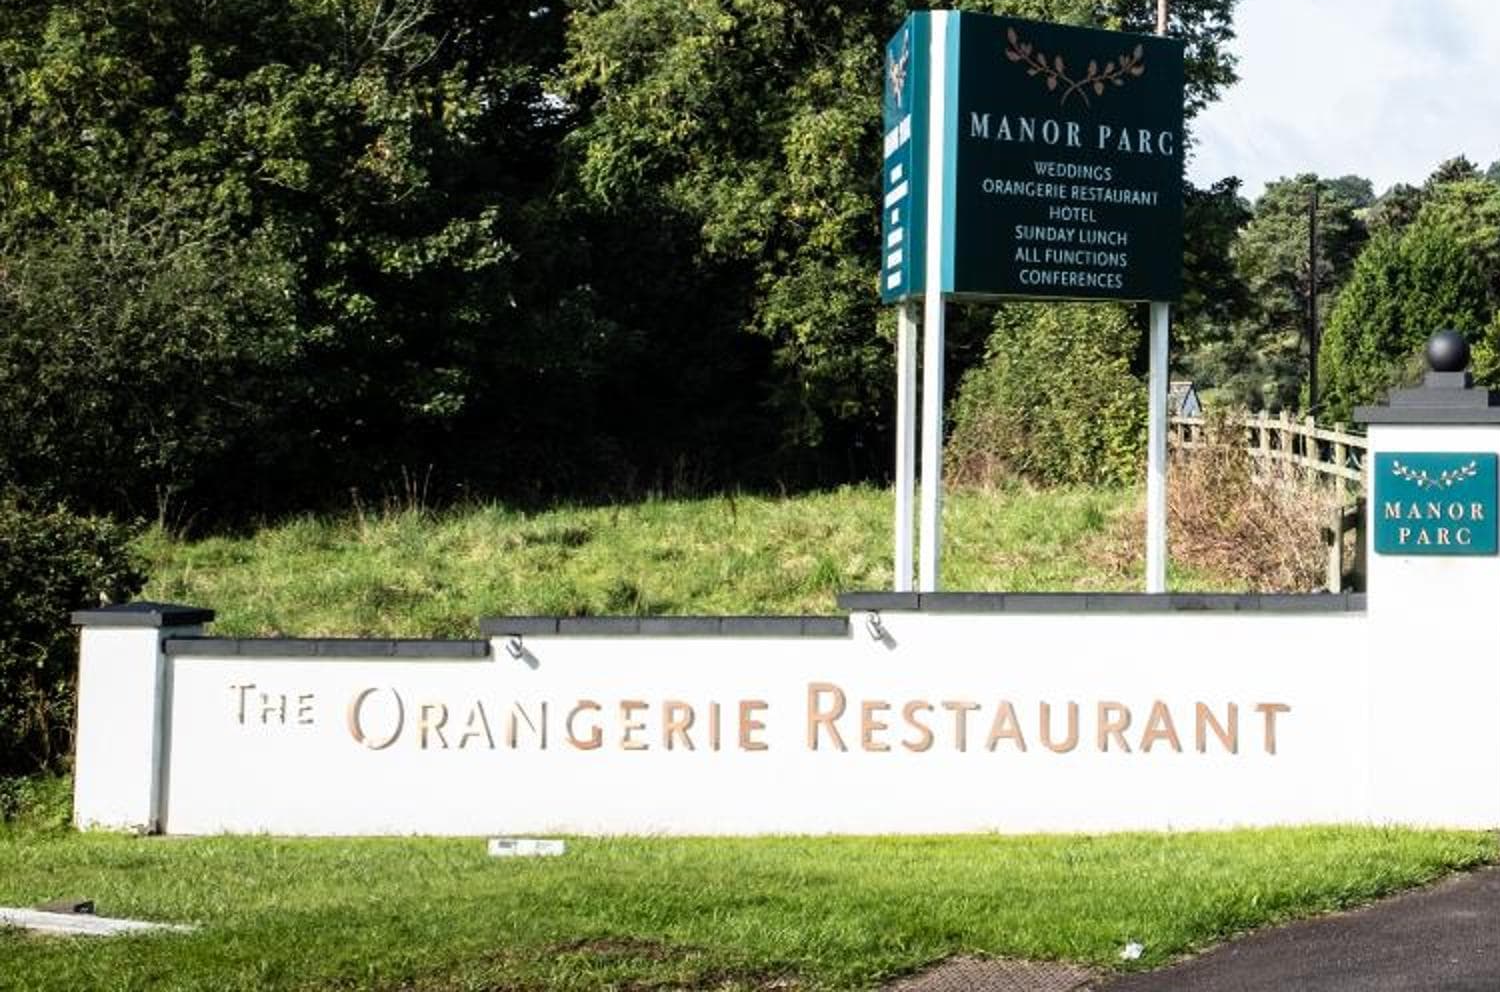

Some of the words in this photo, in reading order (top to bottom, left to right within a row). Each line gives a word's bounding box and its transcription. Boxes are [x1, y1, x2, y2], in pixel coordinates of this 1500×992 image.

[969, 111, 1081, 148] MANOR
[1098, 124, 1174, 156] PARC
[1033, 160, 1113, 181] WEDDINGS
[981, 178, 1067, 199] ORANGERIE
[1070, 184, 1159, 206] RESTAURANT
[1049, 205, 1097, 223] HOTEL
[1014, 224, 1076, 243] SUNDAY
[1079, 229, 1128, 246] LUNCH
[1014, 246, 1042, 264] ALL
[1044, 248, 1128, 268] FUNCTIONS
[1018, 268, 1124, 289] CONFERENCES
[1384, 501, 1485, 521] MANOR
[1398, 527, 1472, 546] PARC
